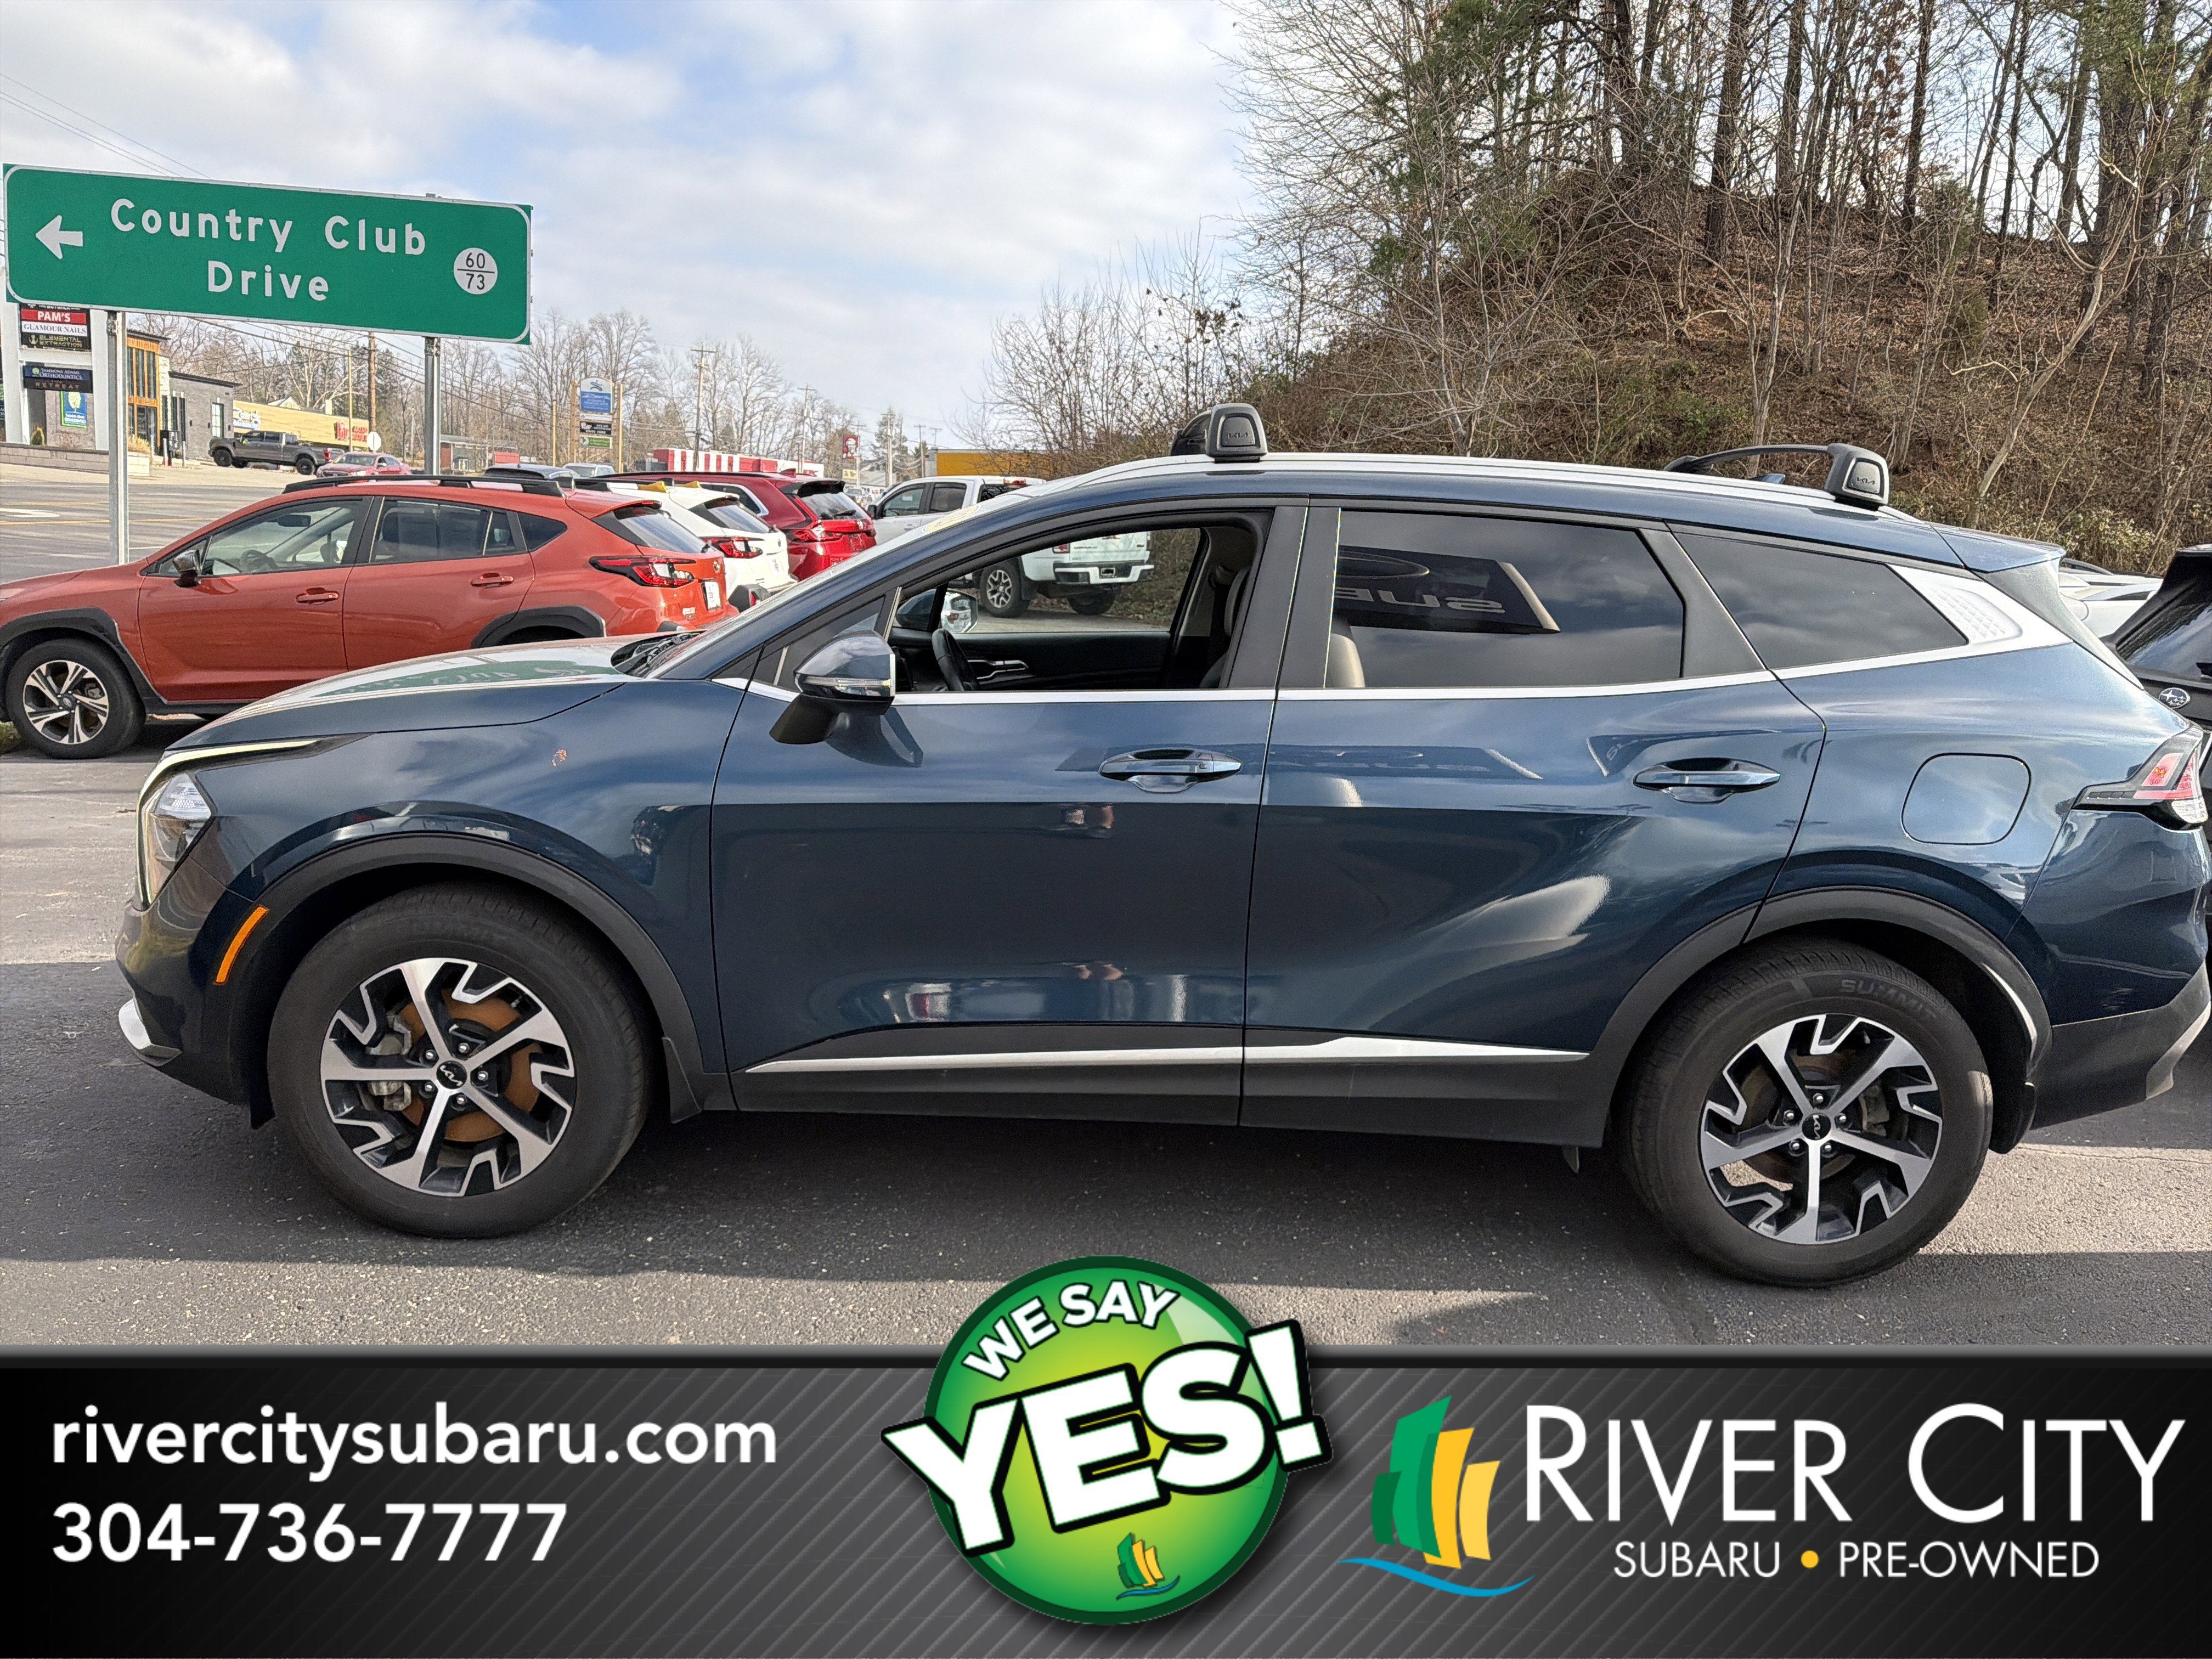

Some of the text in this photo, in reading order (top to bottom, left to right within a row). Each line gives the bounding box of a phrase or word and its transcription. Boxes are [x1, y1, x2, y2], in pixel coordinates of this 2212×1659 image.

[111, 198, 425, 256] Country Club
[466, 252, 486, 269] 60
[208, 260, 329, 301] Drive
[465, 273, 486, 290] 73
[37, 311, 71, 323] PAM'S
[24, 323, 62, 332] GLAMOUR
[39, 335, 82, 343] ELEMENTAL
[39, 340, 82, 348] EXTRACTION
